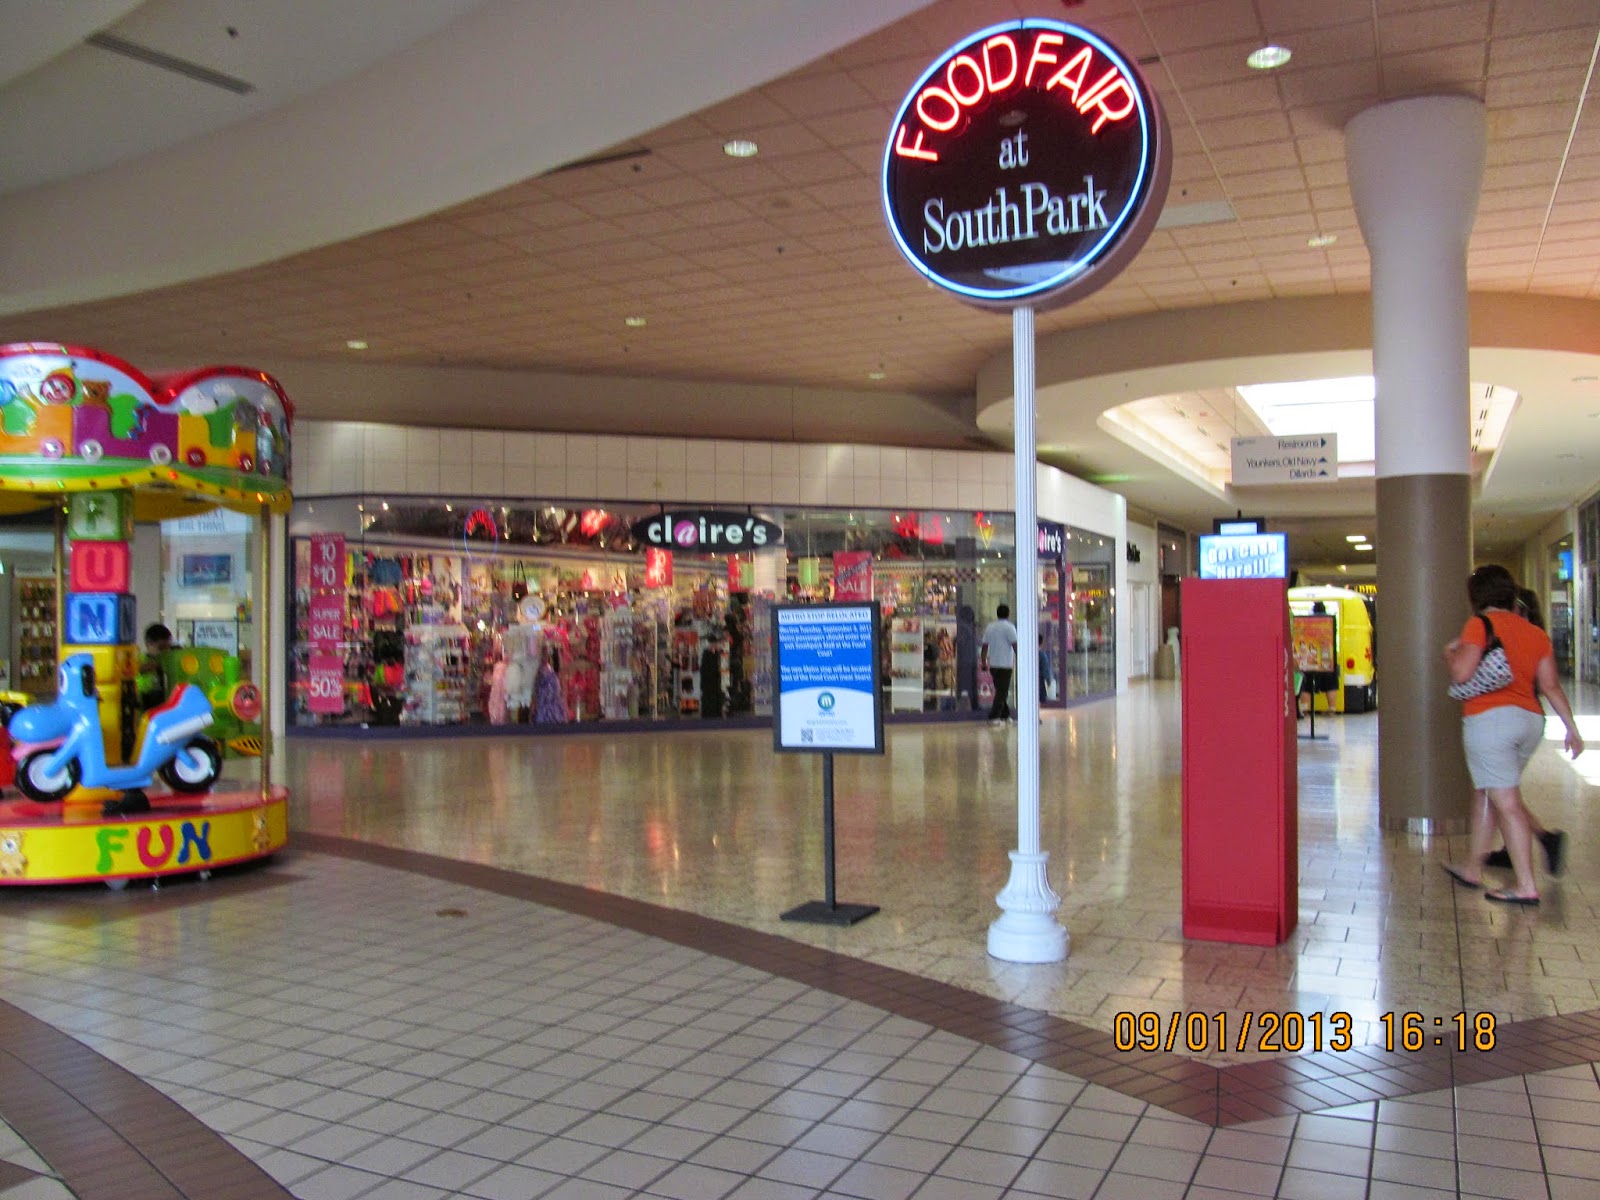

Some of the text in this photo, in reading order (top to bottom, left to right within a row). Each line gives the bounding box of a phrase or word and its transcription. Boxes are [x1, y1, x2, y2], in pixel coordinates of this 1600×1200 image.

[896, 34, 1135, 161] FOOD FAIR
[998, 129, 1029, 170] at
[923, 175, 1112, 254] SouthPark
[1278, 438, 1319, 450] Restrooms
[1296, 457, 1317, 467] Navy
[647, 514, 768, 545] claire's
[312, 624, 339, 640] SALE
[96, 821, 212, 874] FUN
